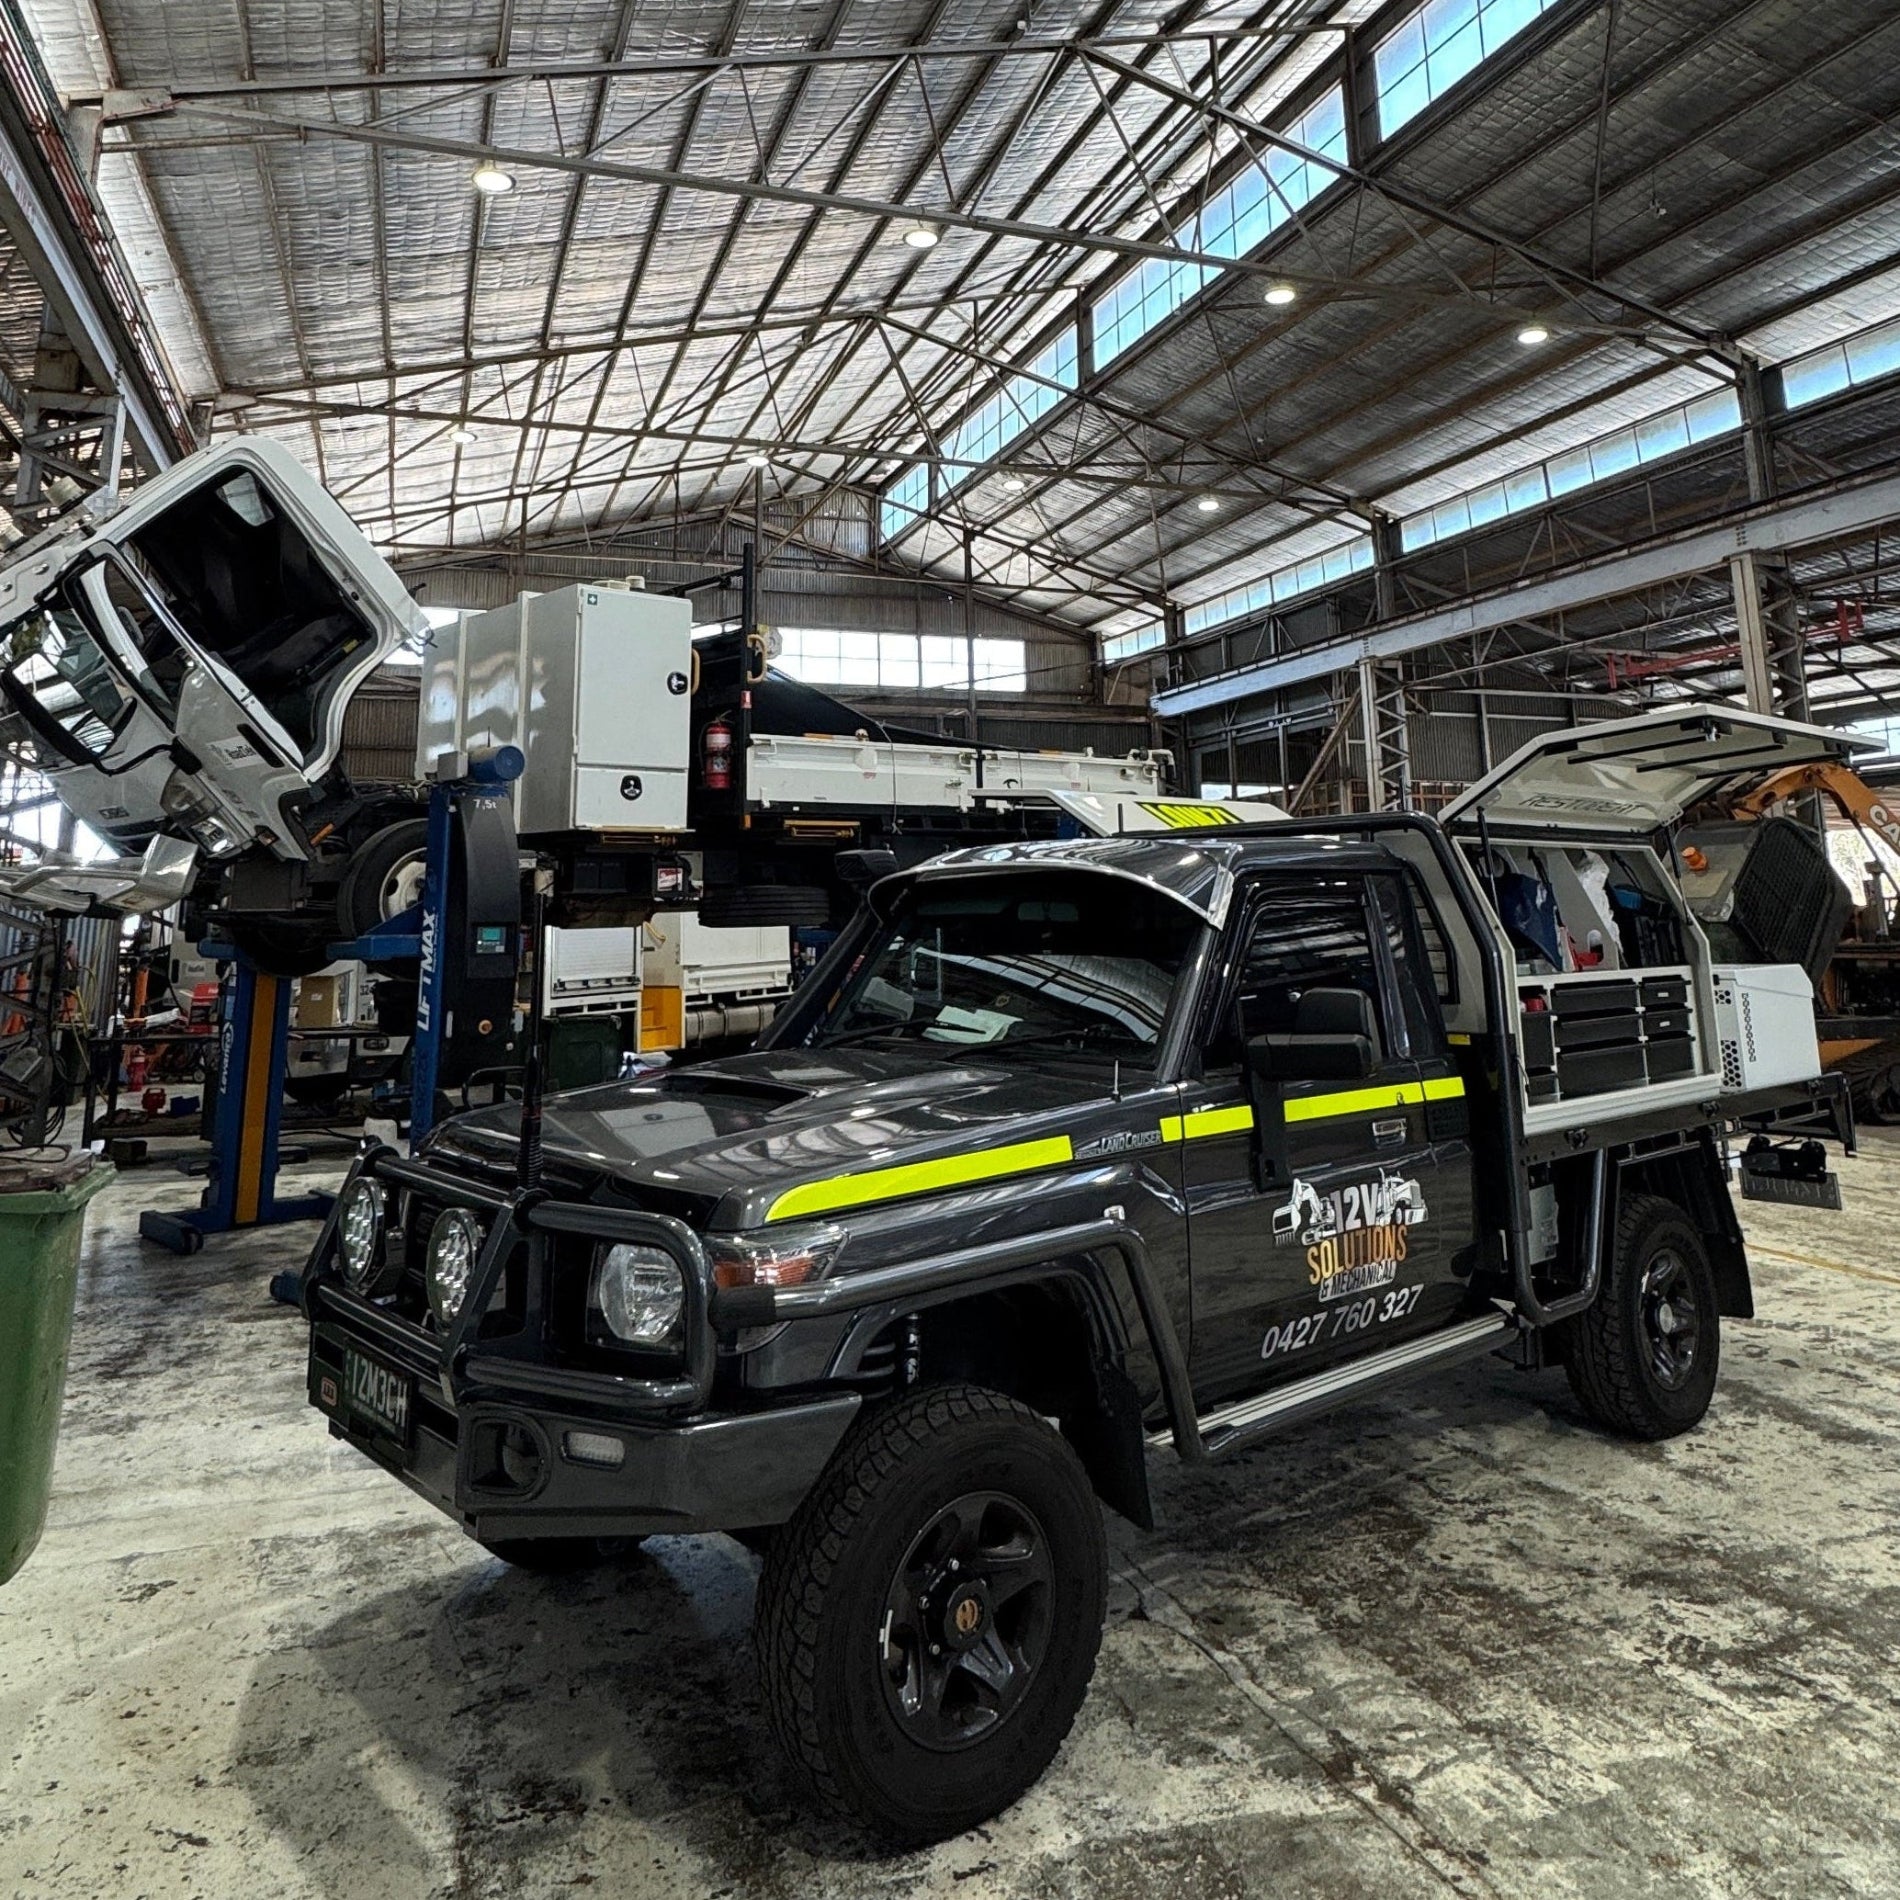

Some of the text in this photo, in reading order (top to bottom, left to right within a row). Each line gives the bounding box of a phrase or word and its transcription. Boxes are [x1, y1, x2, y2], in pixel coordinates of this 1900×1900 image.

[1330, 1182, 1380, 1234] 12V
[1306, 1225, 1408, 1285] SOLUTIONS
[1330, 1264, 1394, 1296] MECHANICAL
[1261, 1283, 1425, 1360] 0427 760 327
